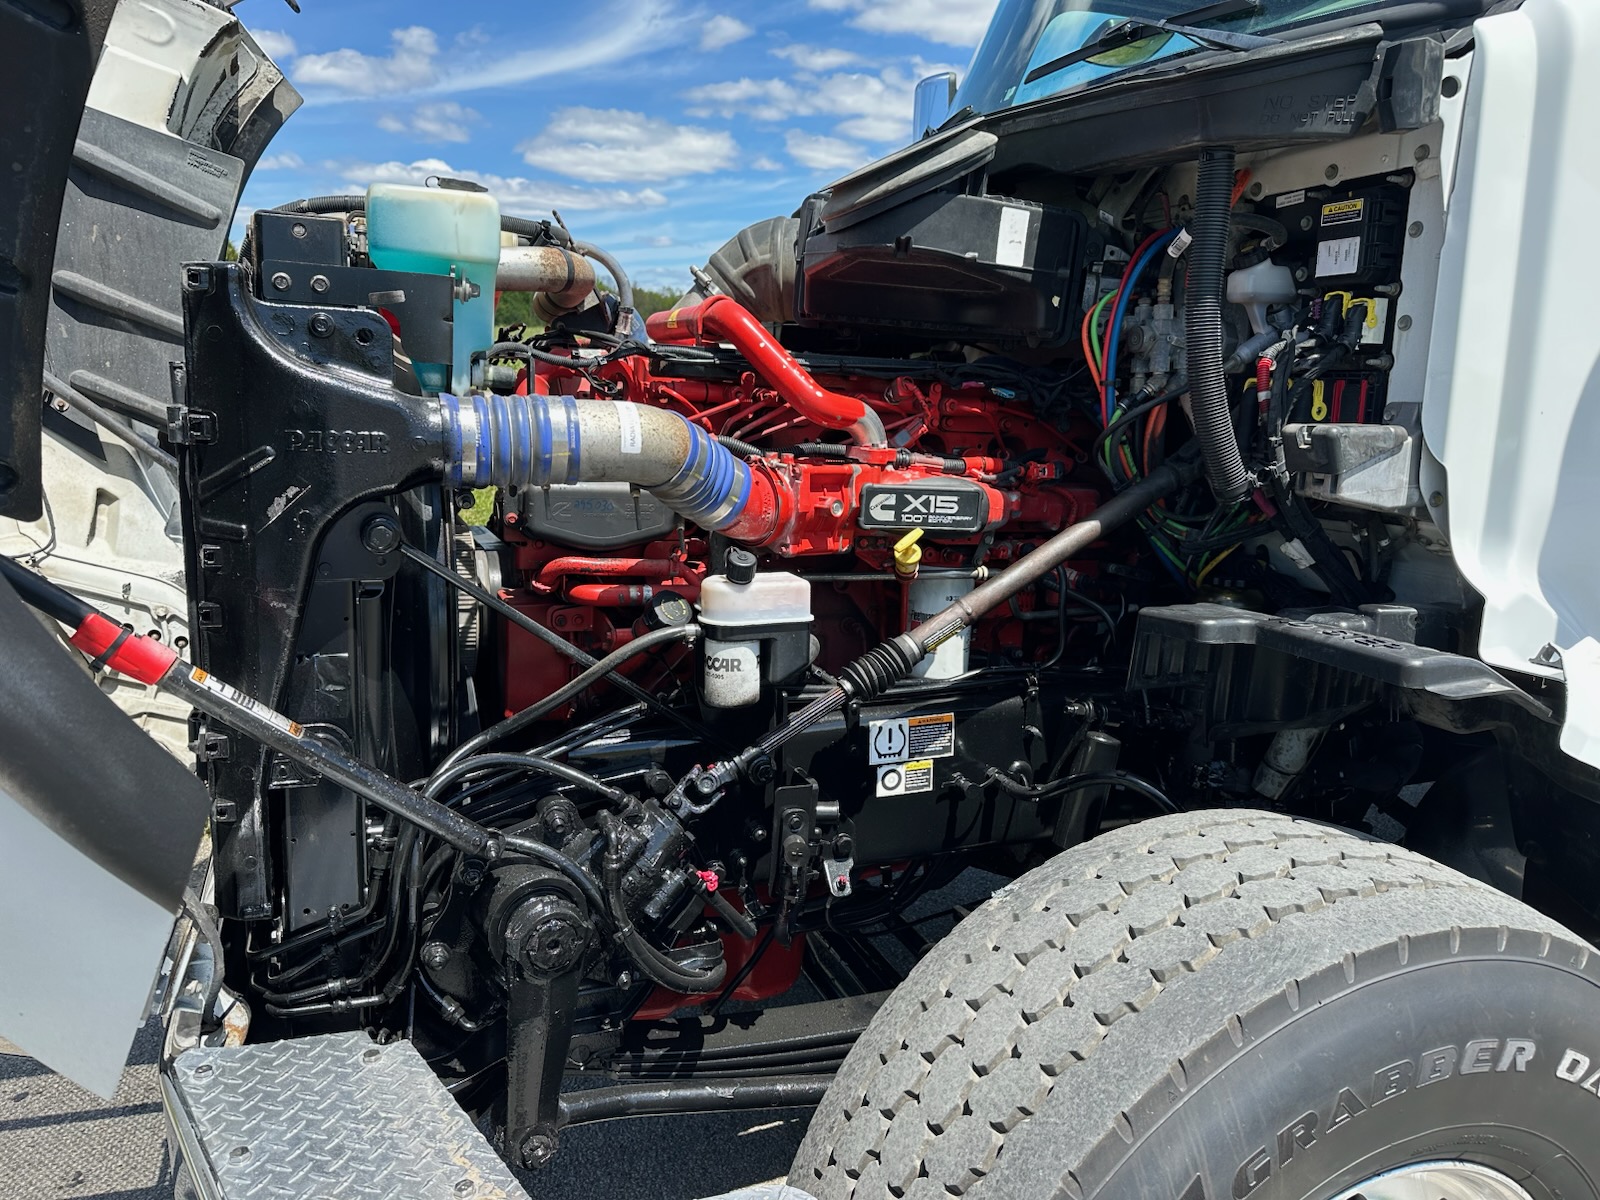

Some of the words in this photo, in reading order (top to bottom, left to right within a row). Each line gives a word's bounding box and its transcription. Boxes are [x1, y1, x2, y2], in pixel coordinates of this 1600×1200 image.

[1263, 95, 1294, 110] NO
[1307, 94, 1357, 111] STEP
[1290, 111, 1319, 126] NOT
[1333, 203, 1358, 212] CAUTION
[902, 494, 959, 514] X15
[1231, 1037, 1537, 1200] GRABBER
